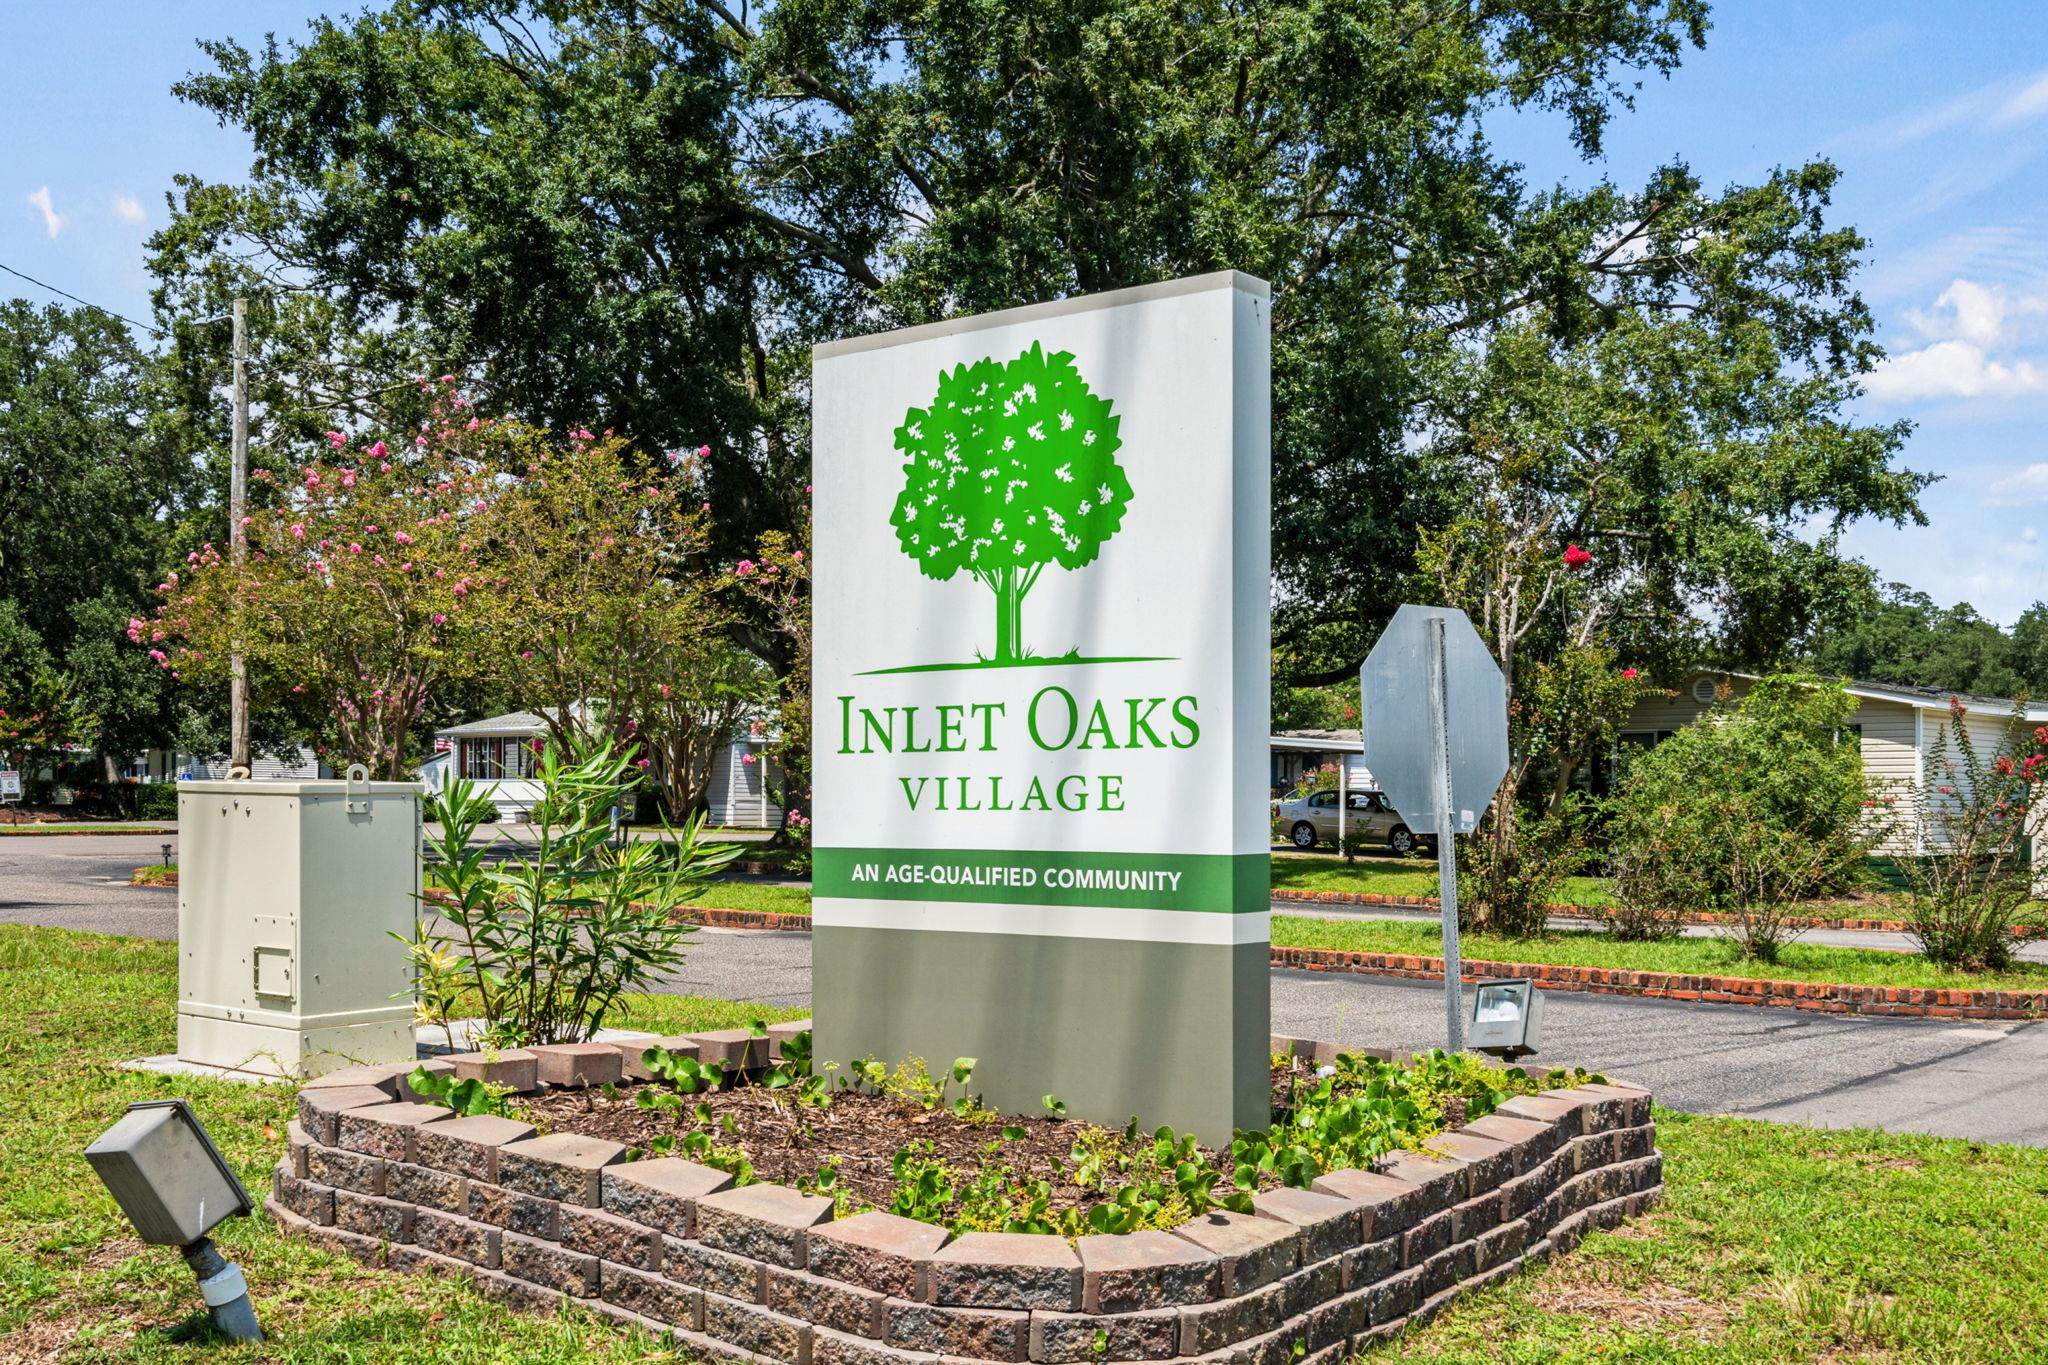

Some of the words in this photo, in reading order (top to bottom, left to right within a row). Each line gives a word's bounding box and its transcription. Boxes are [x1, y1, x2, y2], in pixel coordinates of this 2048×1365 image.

[837, 696, 1006, 754] INLET
[1027, 686, 1201, 751] OAKS
[899, 775, 1125, 812] VILLAGE
[851, 864, 879, 882] AN
[885, 865, 1037, 887] AGE-QUALIFIED
[1044, 869, 1182, 892] COMMUNITY
